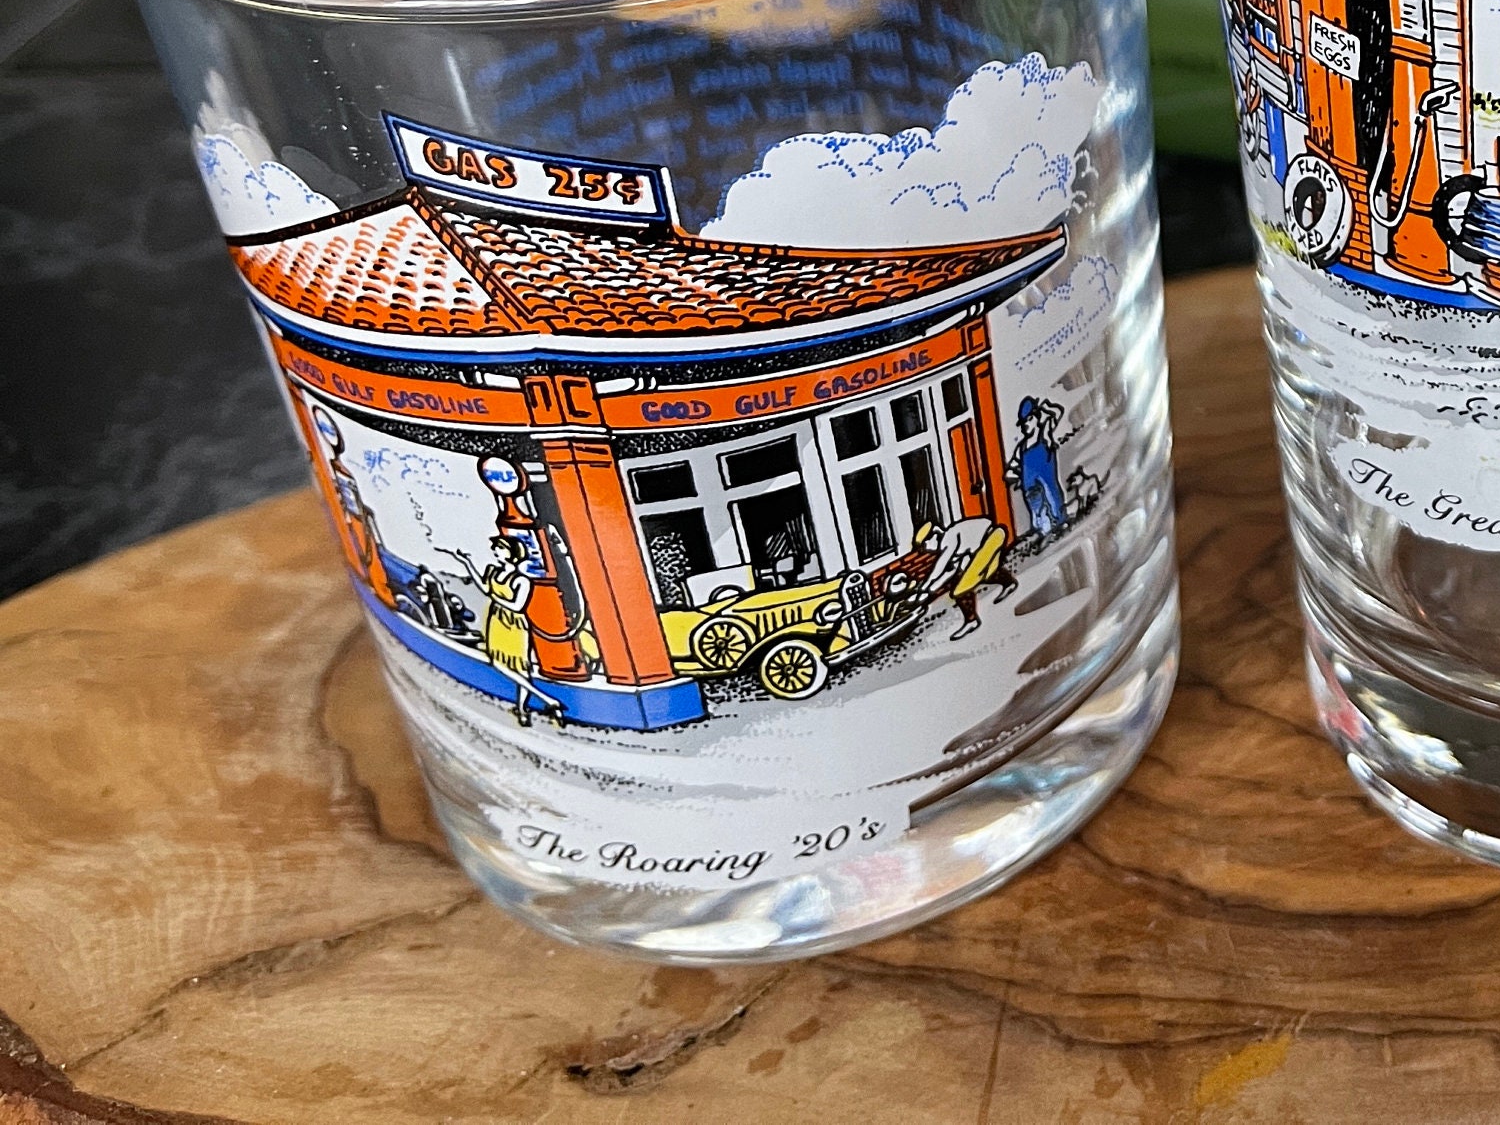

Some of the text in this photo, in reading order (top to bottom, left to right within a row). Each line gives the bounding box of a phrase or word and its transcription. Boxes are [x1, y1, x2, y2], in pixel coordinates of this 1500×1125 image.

[1313, 22, 1357, 54] FRESH
[1313, 41, 1353, 72] EGGS
[423, 136, 518, 189] GAS
[542, 161, 644, 206] 25¢
[1297, 158, 1338, 194] FLATS
[331, 373, 376, 401] GULF
[386, 388, 490, 416] GASOLINE
[640, 347, 934, 423] GOOD GULF GASOLINE
[1347, 457, 1416, 508] The
[516, 815, 888, 881] The Roaring '20's
